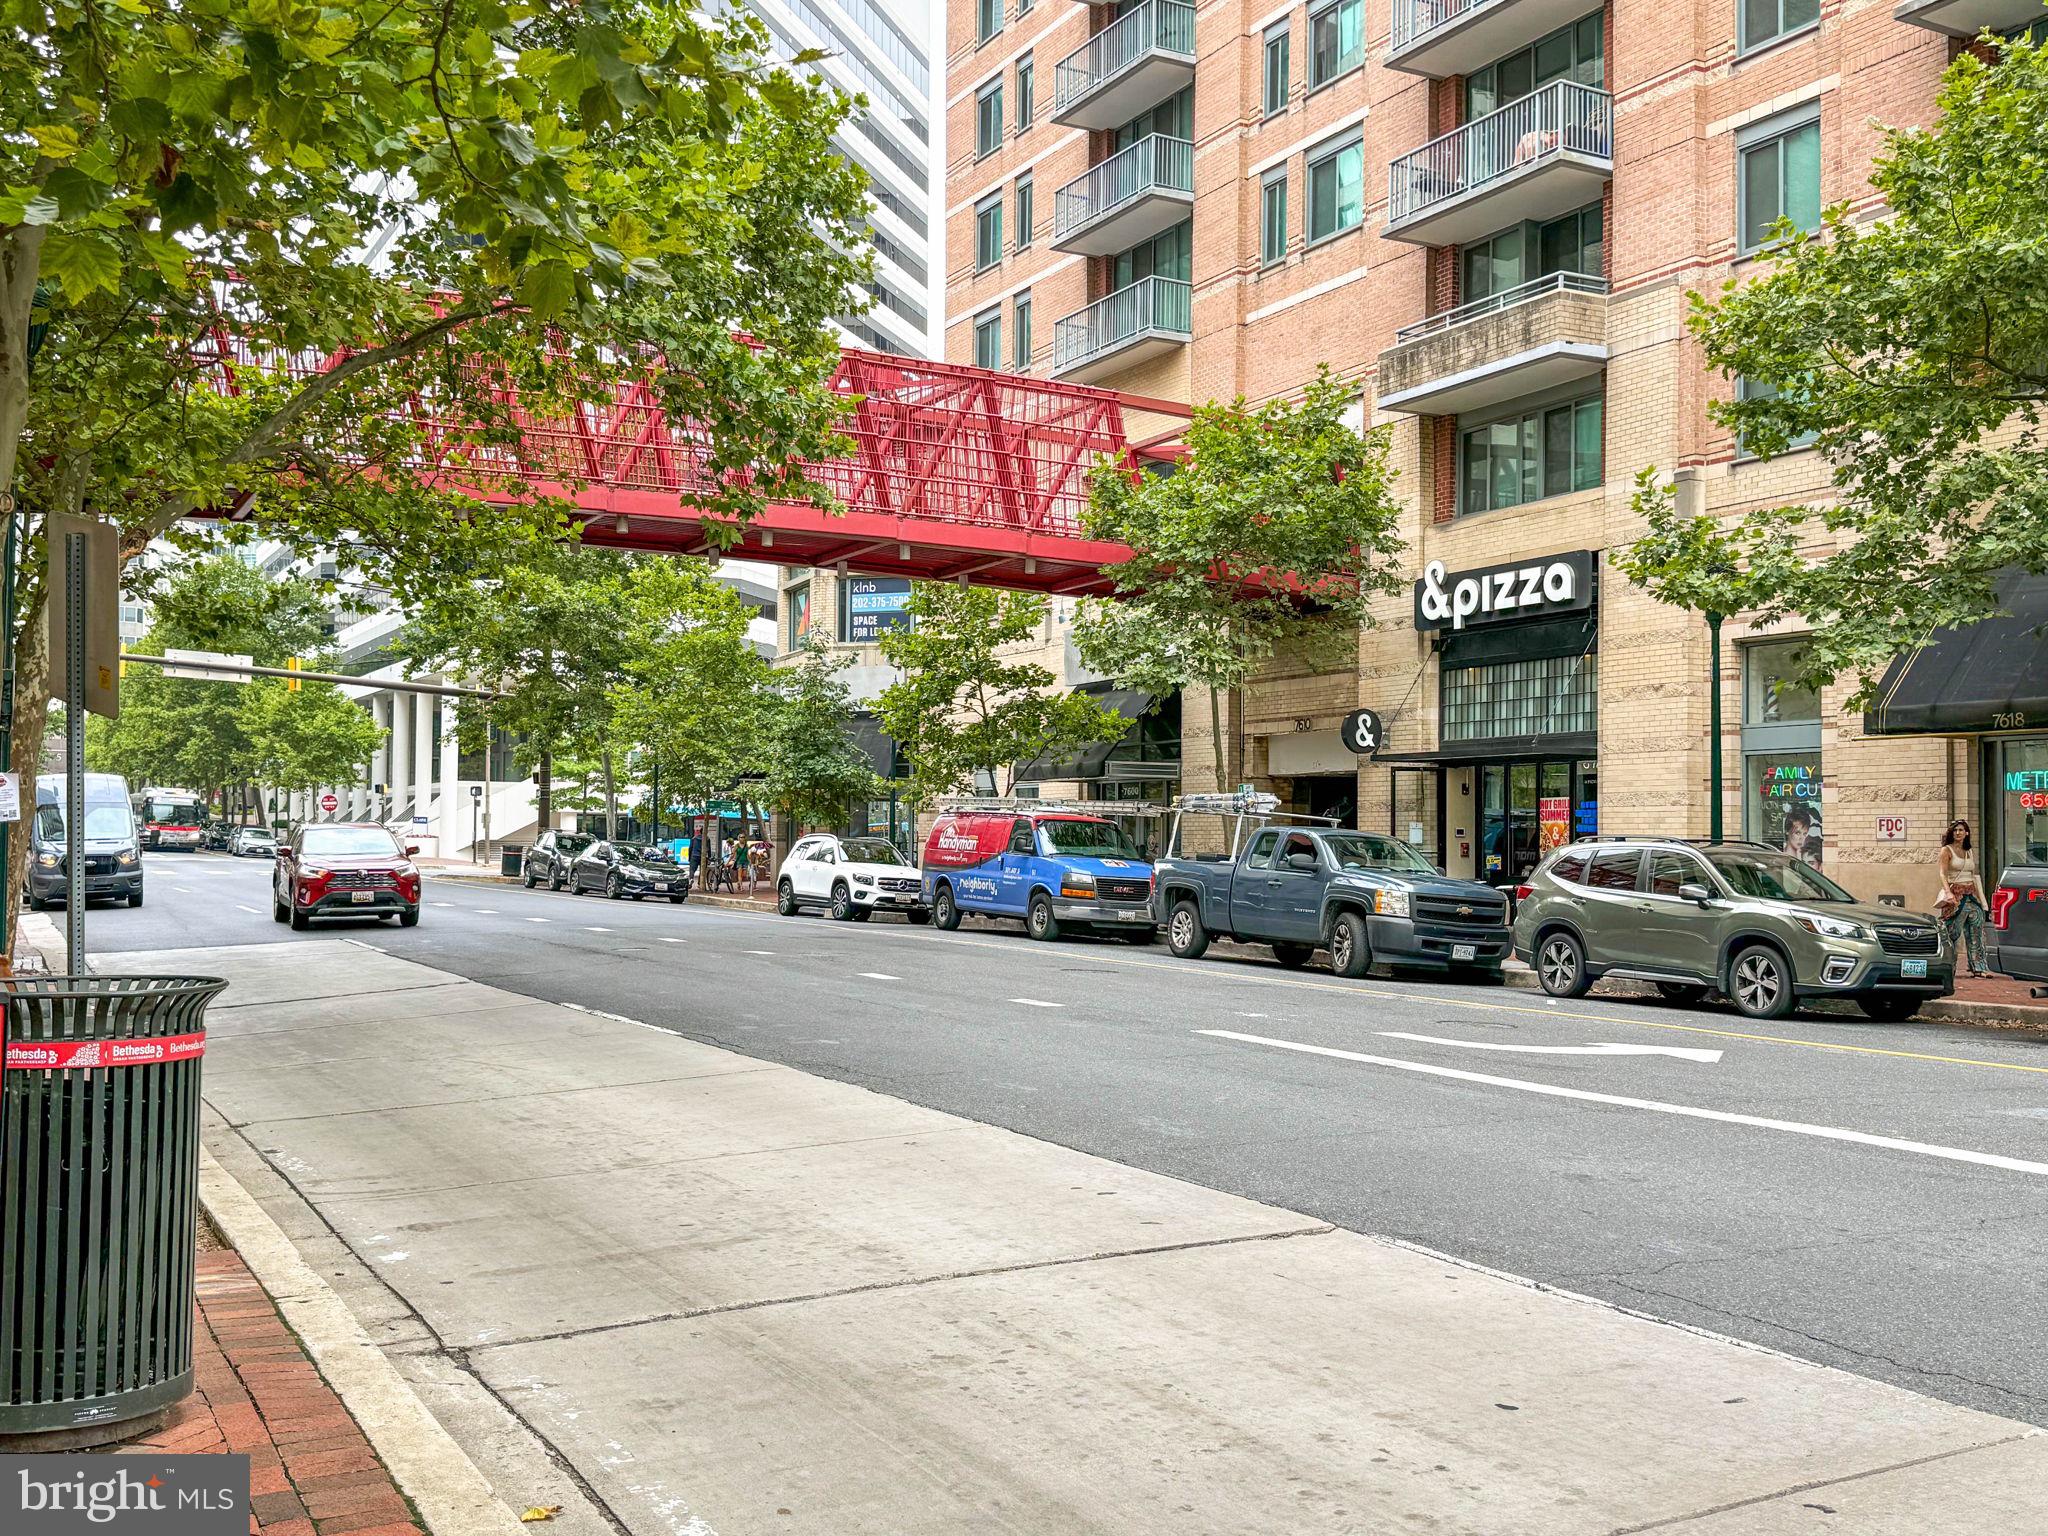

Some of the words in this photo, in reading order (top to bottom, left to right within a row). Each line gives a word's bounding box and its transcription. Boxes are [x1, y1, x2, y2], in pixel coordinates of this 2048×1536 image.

[853, 581, 877, 593] klnb
[1421, 559, 1576, 630] &pizza
[853, 615, 878, 626] SPACE
[853, 627, 868, 637] FOR
[869, 626, 893, 637] LESE
[1294, 717, 1312, 732] 7610
[1992, 711, 2025, 729] 7618
[1355, 713, 1376, 748] &
[1766, 765, 1816, 780] FAMILY
[1759, 783, 1793, 798] HAIR
[1540, 799, 1552, 810] HOT
[1540, 809, 1569, 822] SUMMER
[1878, 818, 1903, 832] FDC
[938, 830, 977, 853] Handyman
[7, 1048, 47, 1059] ethesda
[113, 1044, 155, 1056] Bethesda
